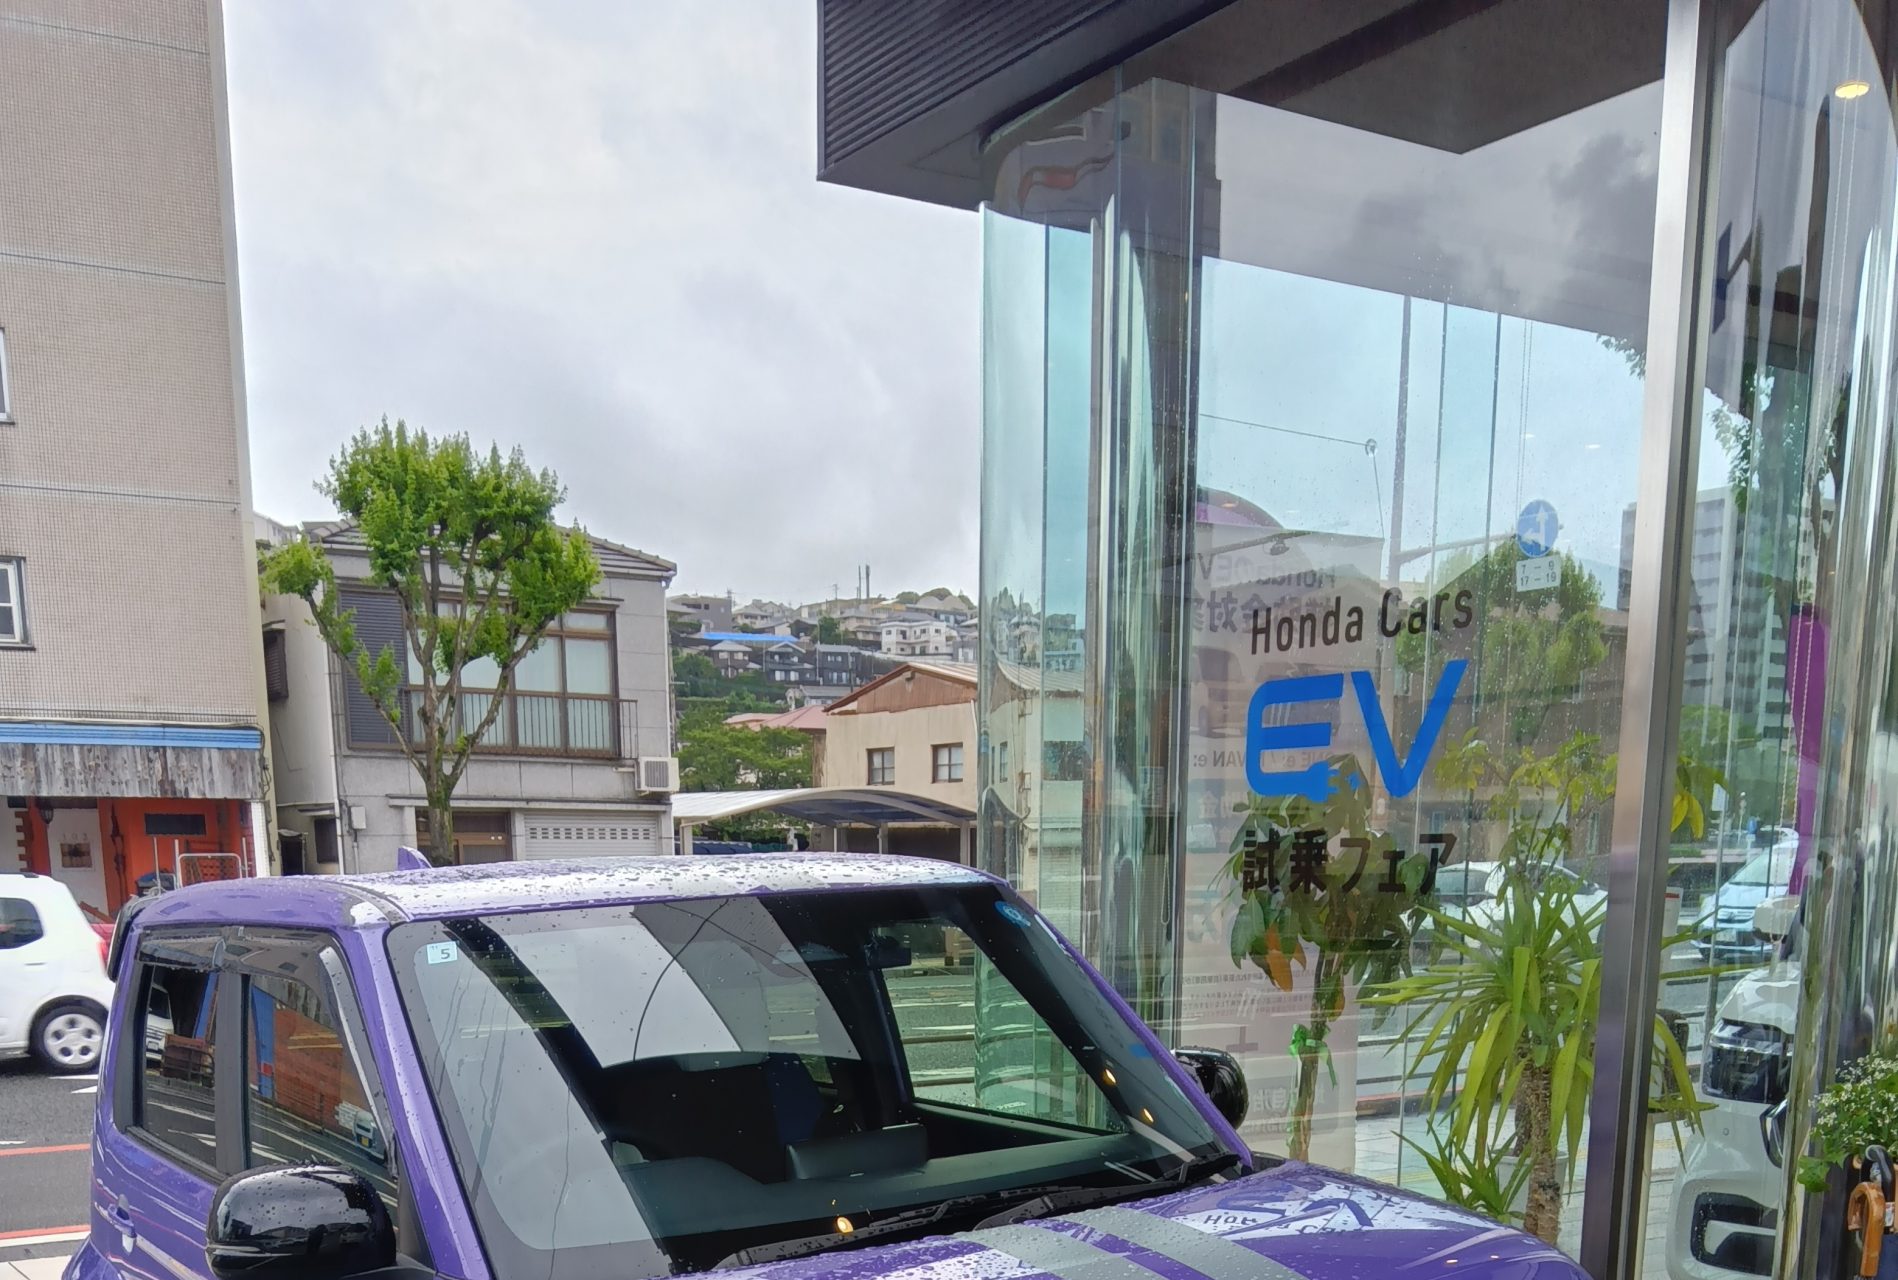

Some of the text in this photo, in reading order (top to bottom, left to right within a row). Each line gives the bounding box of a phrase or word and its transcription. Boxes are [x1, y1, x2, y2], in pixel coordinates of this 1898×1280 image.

[1520, 575, 1529, 587] 17
[1252, 586, 1473, 655] Honda Cars
[1245, 659, 1469, 803] EV
[1243, 828, 1458, 895] 試乗フェア
[440, 948, 450, 960] 5
